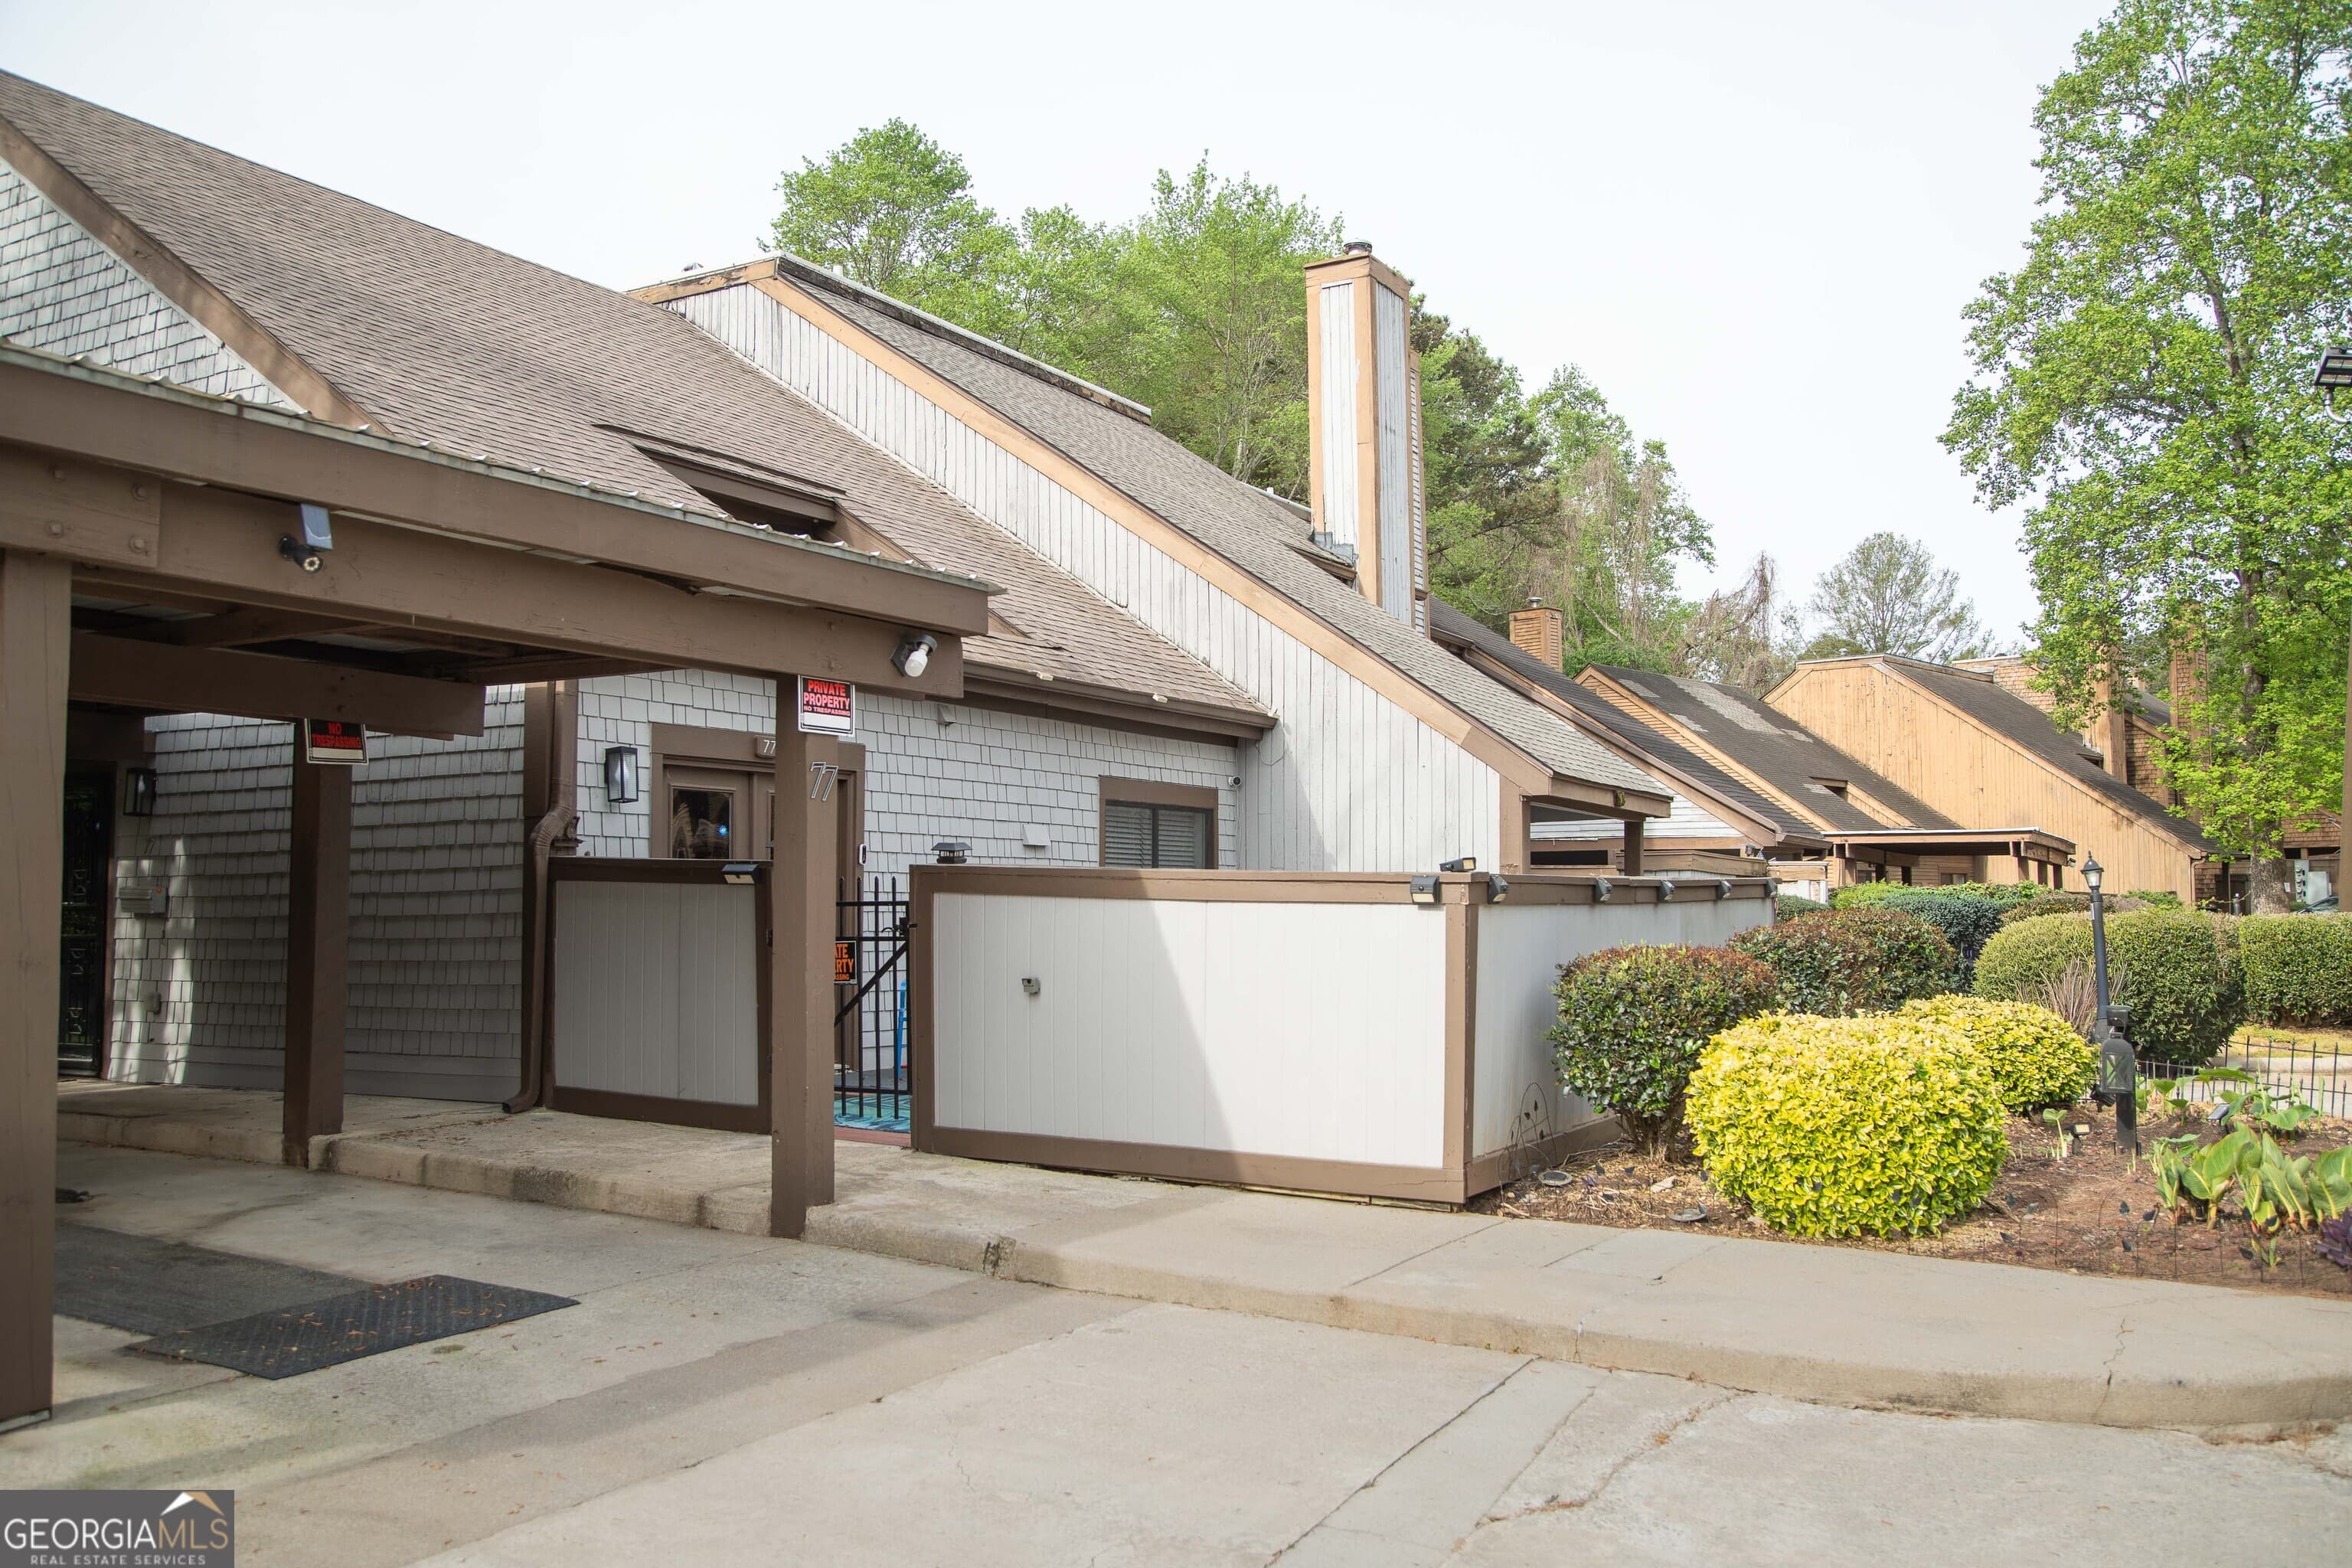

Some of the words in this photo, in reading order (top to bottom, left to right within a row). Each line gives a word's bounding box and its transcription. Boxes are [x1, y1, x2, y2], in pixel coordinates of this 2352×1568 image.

[808, 680, 846, 696] PRIVATE
[803, 692, 851, 710] PROPERTY
[813, 706, 851, 717] TRESPASSING
[328, 722, 342, 735] NO
[312, 733, 362, 749] TRESPASSING
[763, 740, 776, 754] 77
[811, 761, 838, 802] 77
